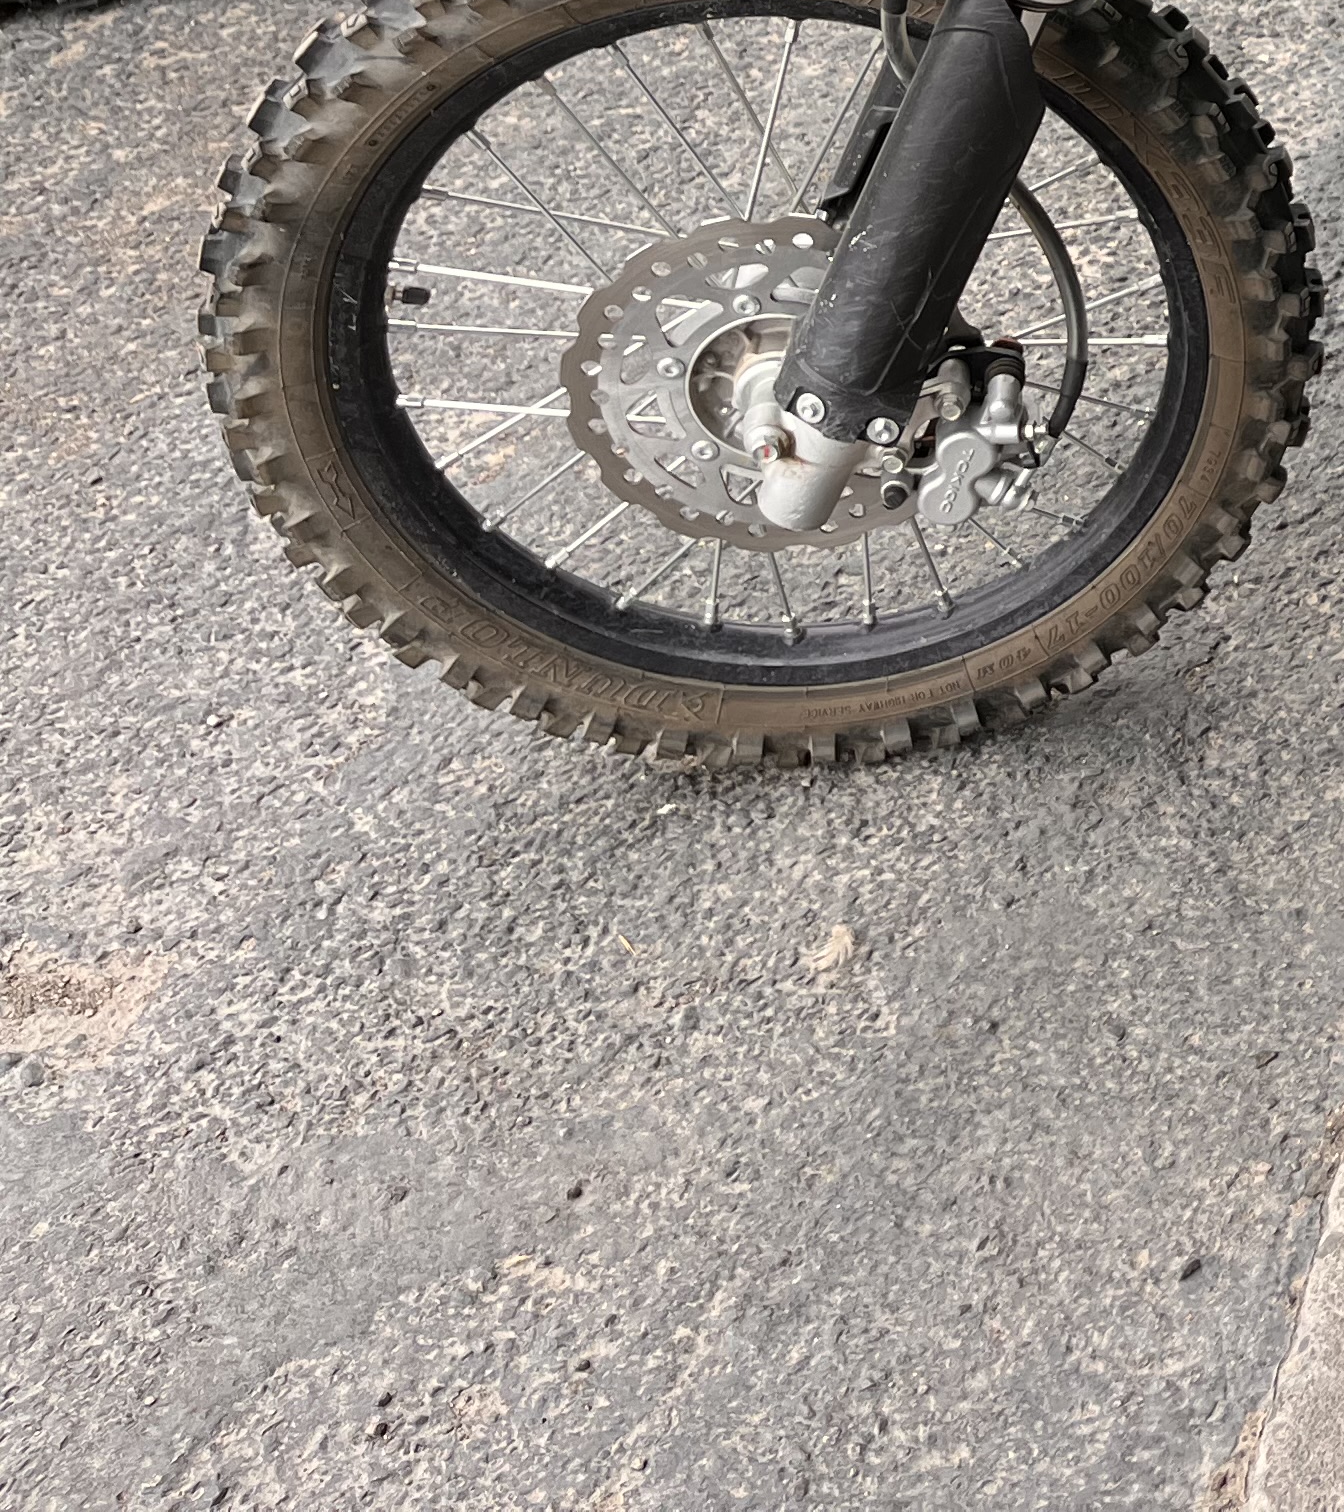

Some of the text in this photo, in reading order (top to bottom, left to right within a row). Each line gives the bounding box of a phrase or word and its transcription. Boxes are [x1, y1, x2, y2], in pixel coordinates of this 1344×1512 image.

[939, 448, 977, 514] TOKICO
[1046, 494, 1198, 652] 70/100-17
[417, 593, 673, 717] DUNLOP
[857, 694, 908, 713] HIGHWAY
[938, 679, 962, 700] NOT
